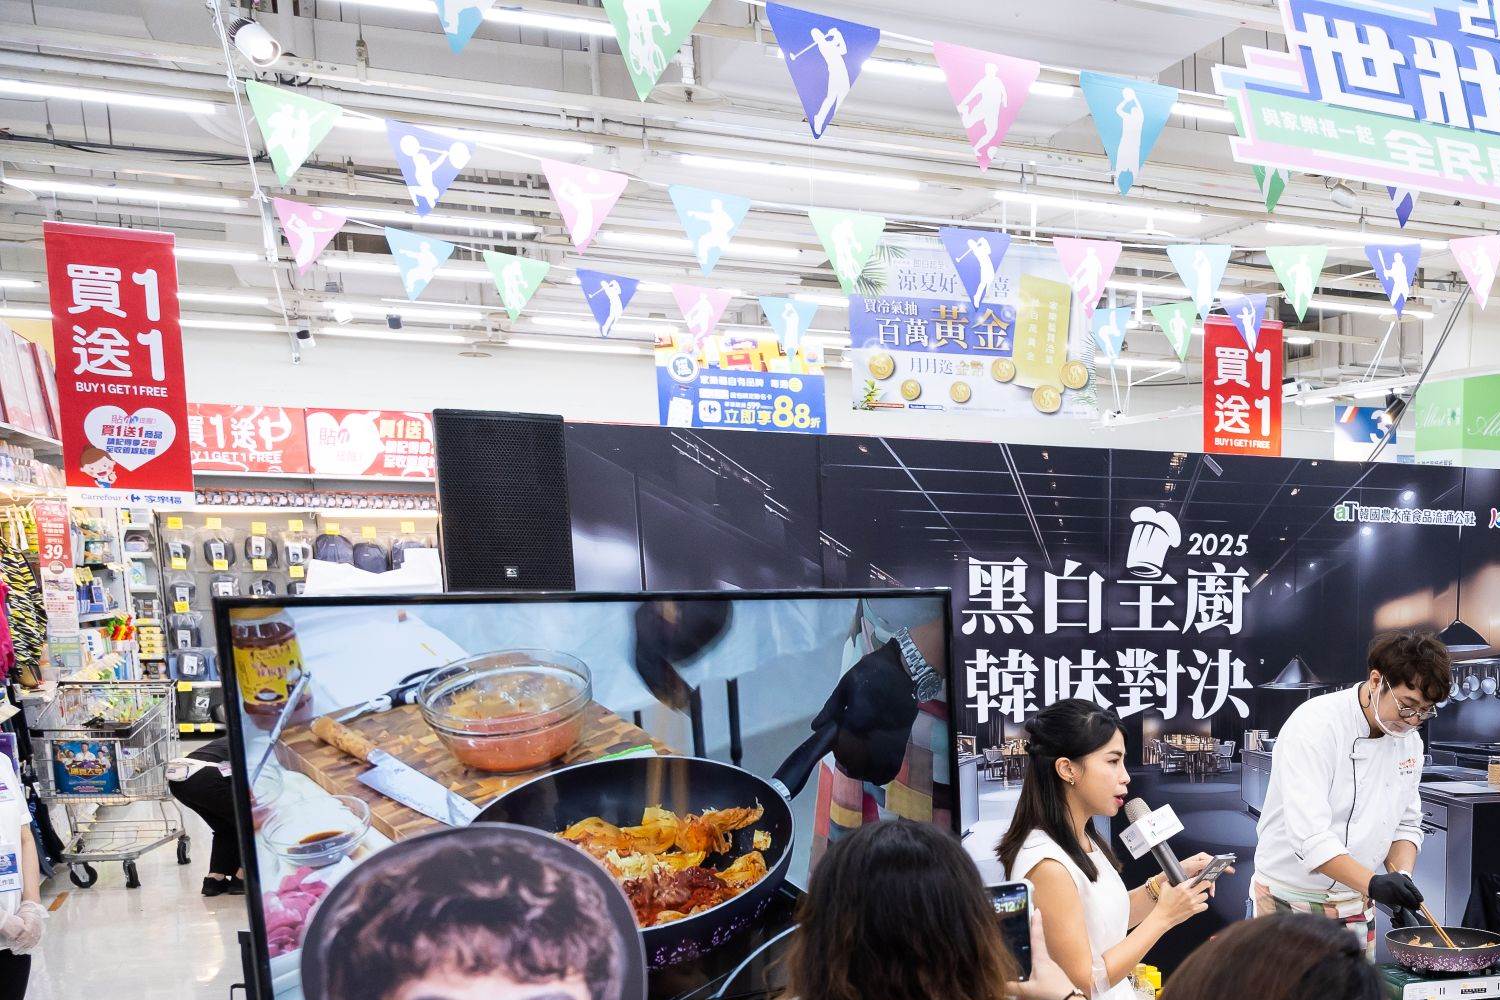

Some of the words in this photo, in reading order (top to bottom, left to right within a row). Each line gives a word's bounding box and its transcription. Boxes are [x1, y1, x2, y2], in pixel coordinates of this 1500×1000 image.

[1261, 106, 1376, 145] 與家樂福一起
[864, 298, 919, 316] 買冷氣抽
[876, 304, 1011, 352] 百萬黃金
[1187, 534, 1248, 556] 2025
[961, 556, 1250, 634] 黑白主廚
[964, 648, 1253, 723] 韓味對決
